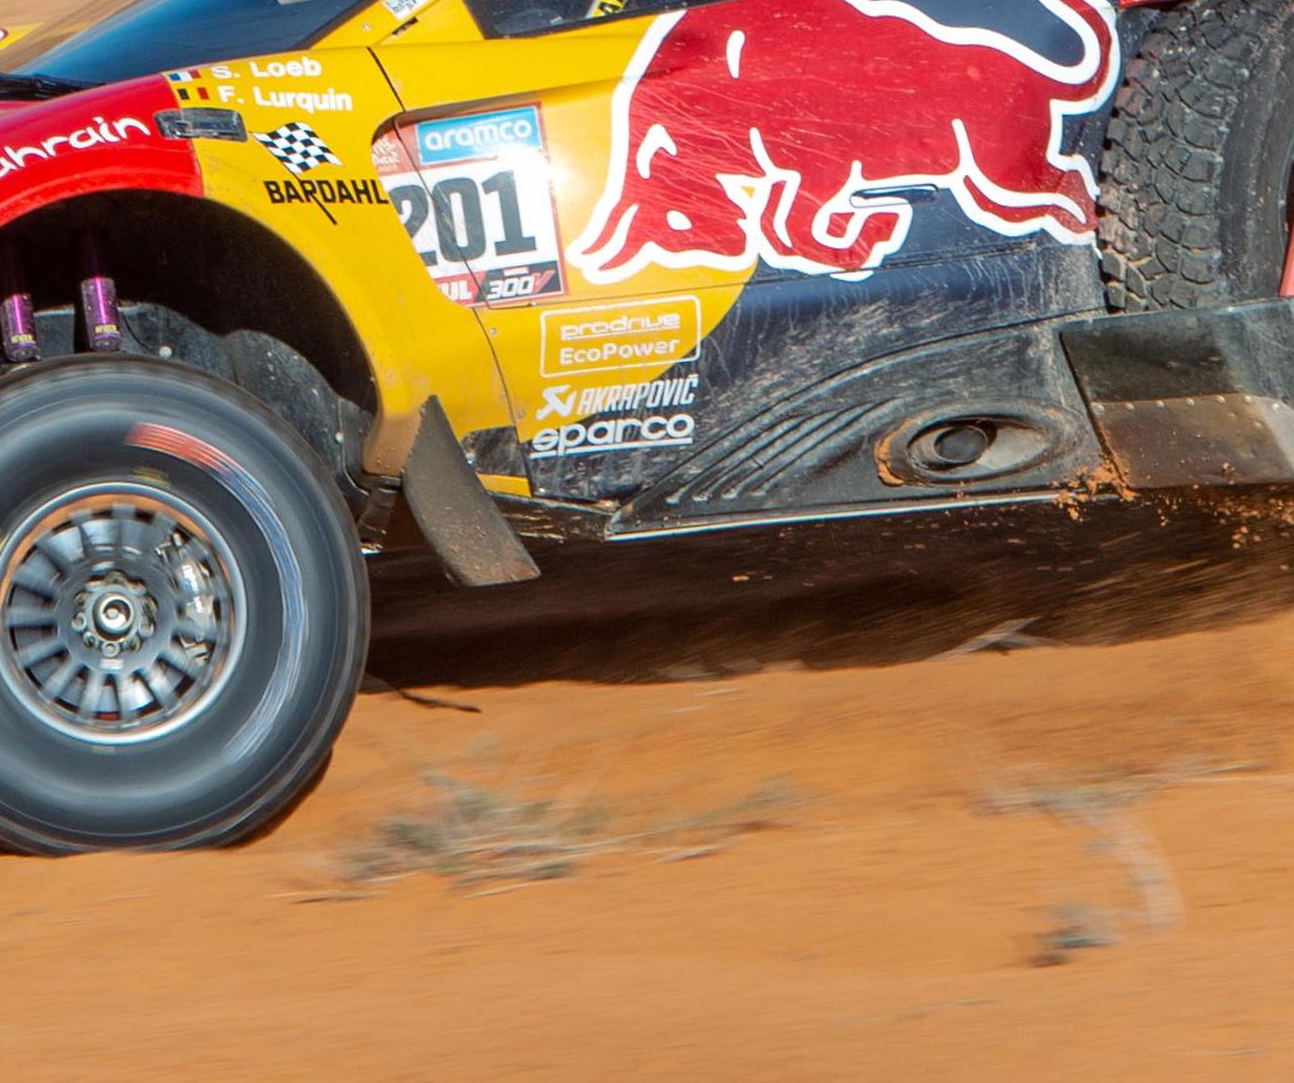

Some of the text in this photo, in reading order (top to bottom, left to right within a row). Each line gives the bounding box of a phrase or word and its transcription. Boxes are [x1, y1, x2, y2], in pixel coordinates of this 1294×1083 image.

[211, 56, 322, 80] S. Loeb
[217, 85, 353, 115] F. Lurquin
[424, 119, 533, 151] aramco
[263, 179, 390, 205] BARDAHL
[387, 169, 538, 267] 201
[486, 270, 556, 300] 300V
[561, 313, 681, 341] prodrive
[559, 339, 681, 366] EcoPower
[530, 413, 696, 460] sparco
